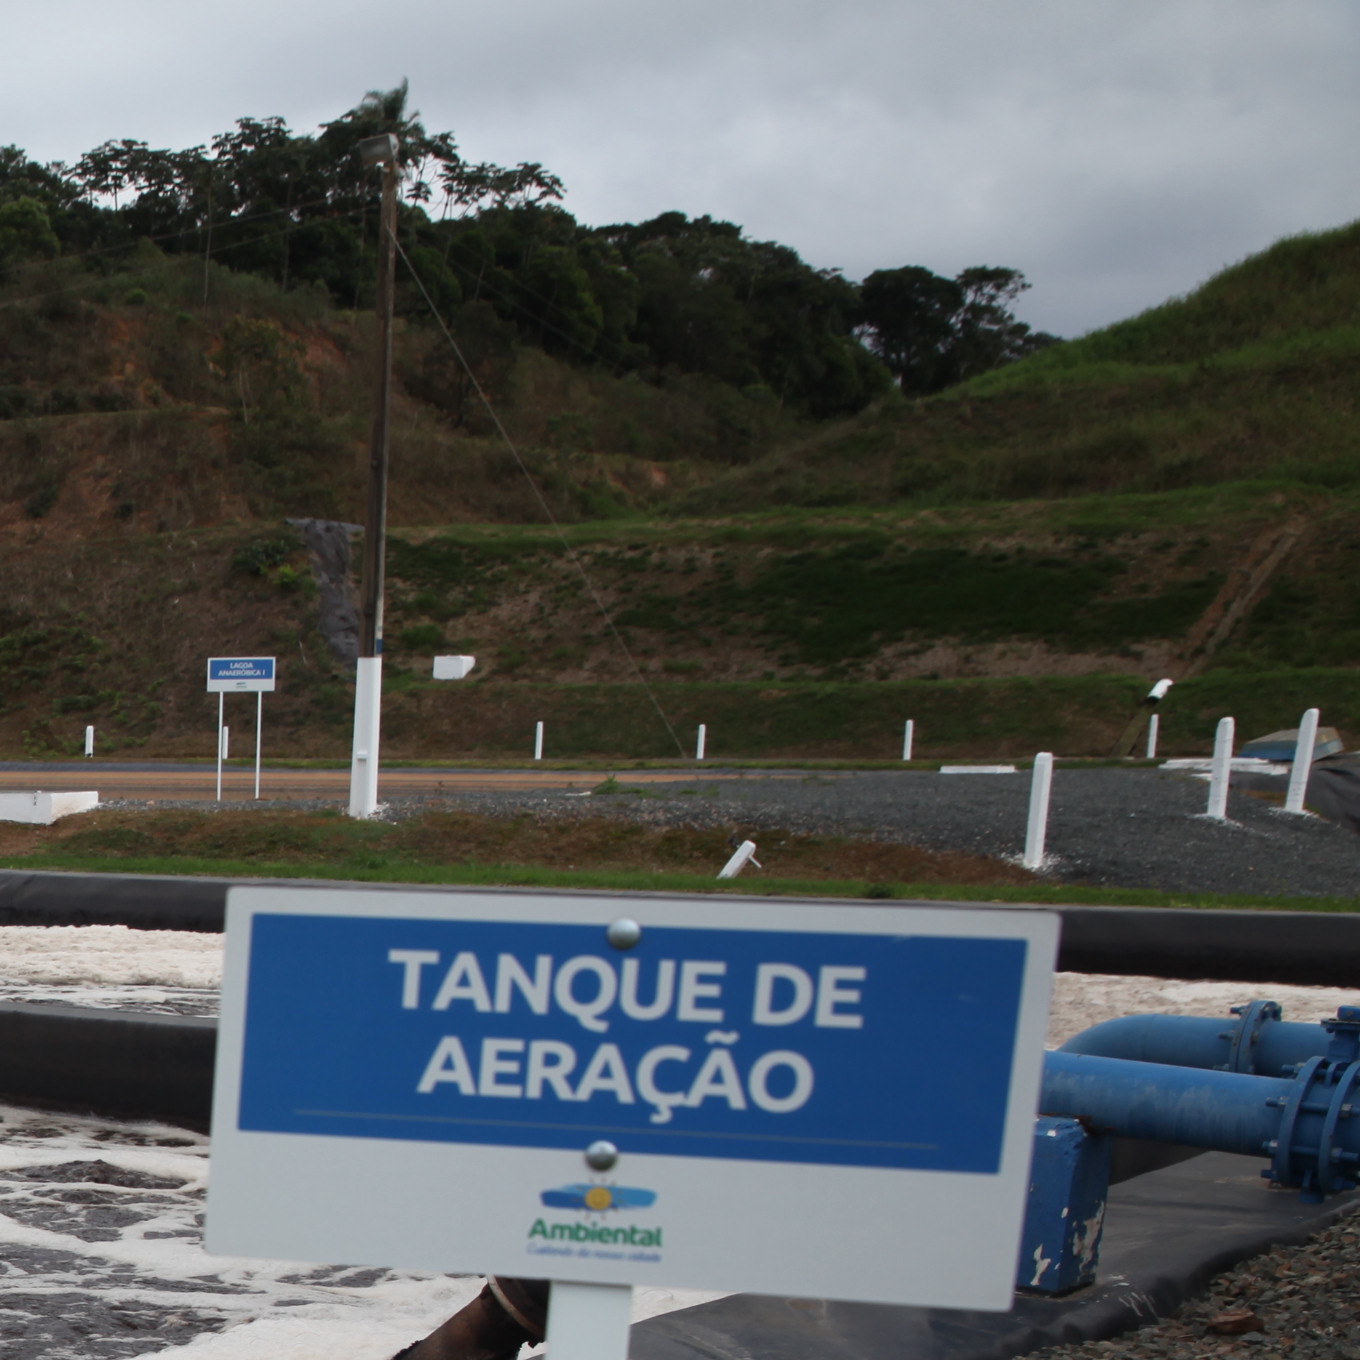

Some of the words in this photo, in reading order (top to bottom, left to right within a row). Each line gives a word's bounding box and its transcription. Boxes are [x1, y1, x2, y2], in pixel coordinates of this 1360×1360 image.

[388, 949, 727, 1033] TANQUE
[752, 963, 866, 1029] DE
[416, 1029, 815, 1125] AERAÇÃO
[528, 1218, 662, 1247] Ambiental
